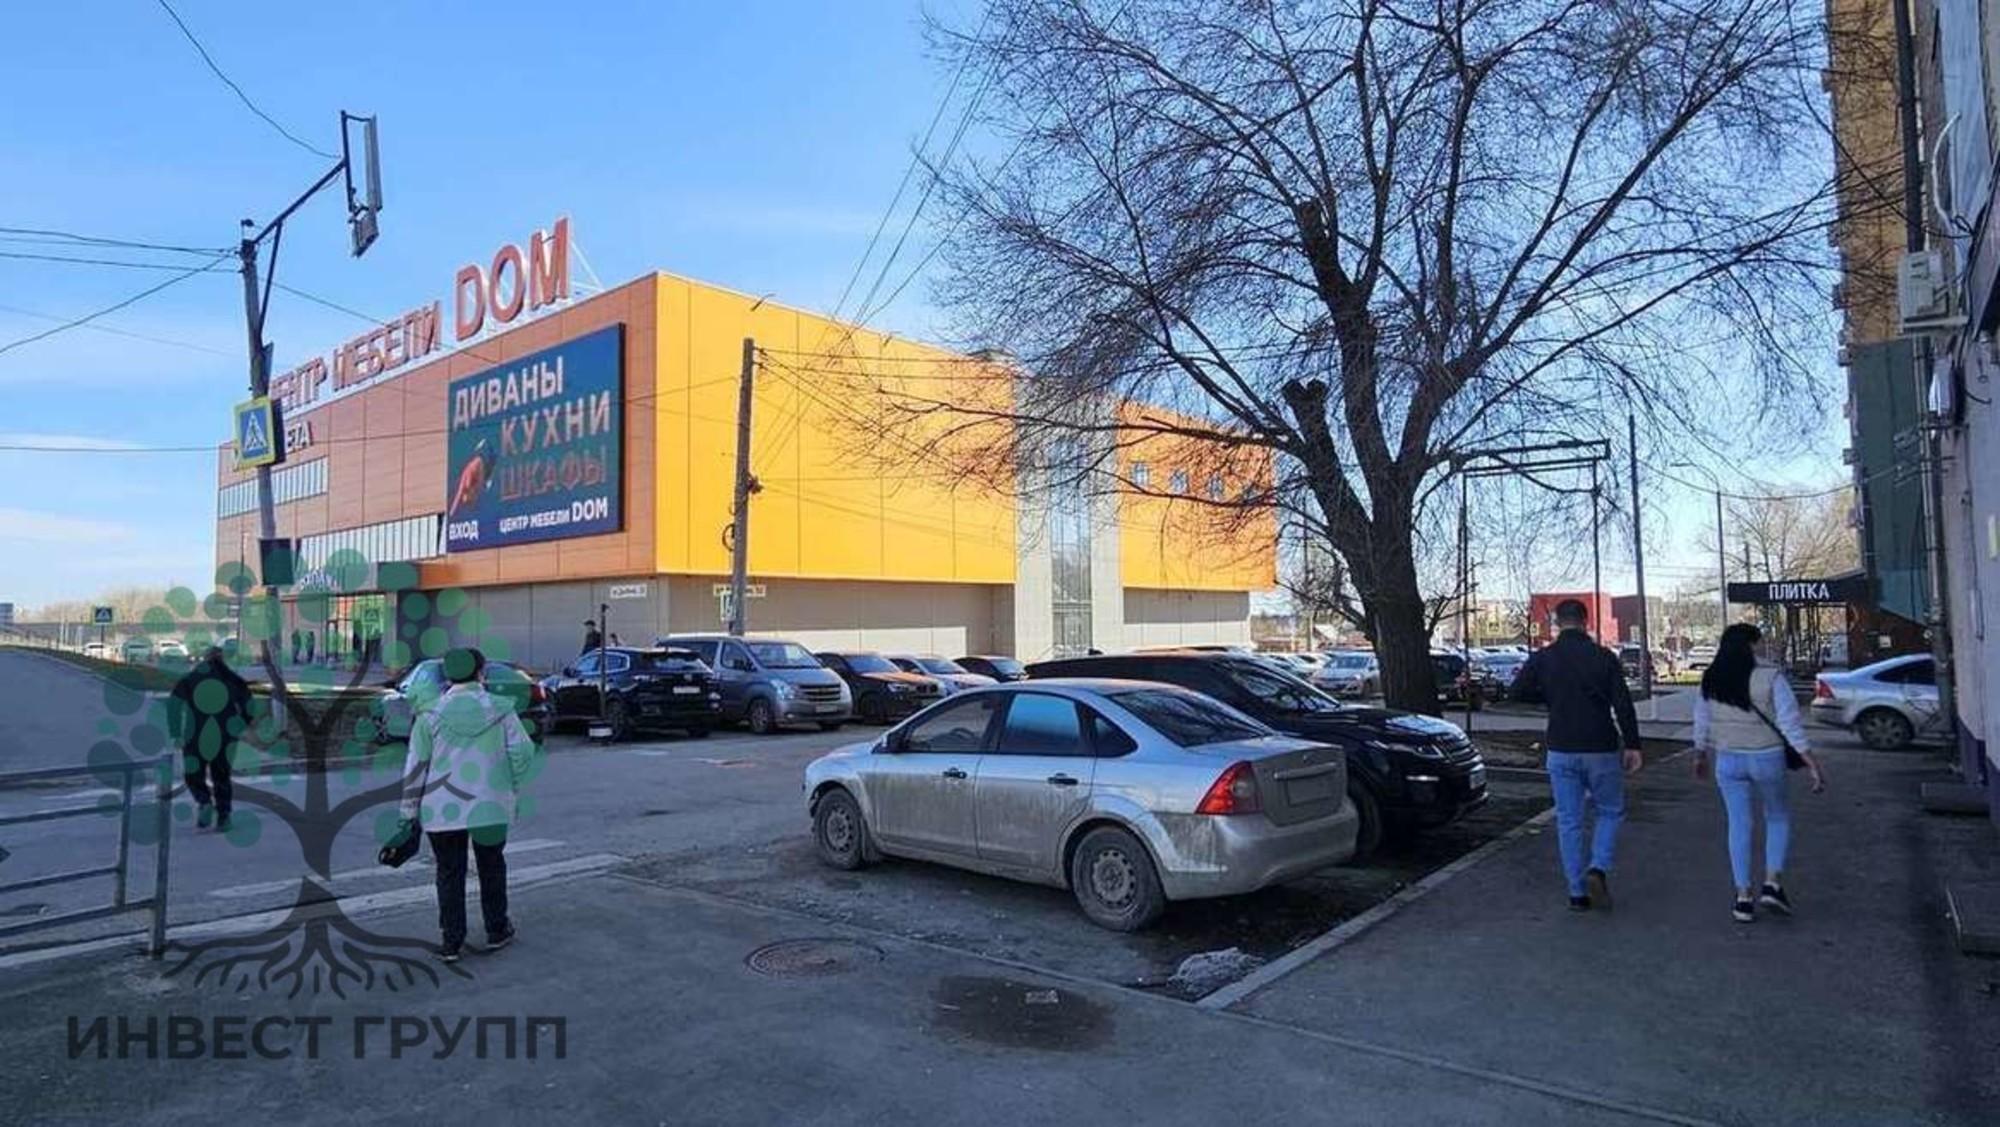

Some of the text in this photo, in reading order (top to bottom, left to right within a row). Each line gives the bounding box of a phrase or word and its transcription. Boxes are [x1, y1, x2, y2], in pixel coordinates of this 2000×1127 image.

[270, 217, 569, 413] ЕНТР МЕБЕЛИ DOM
[453, 355, 564, 432] ДИВАНЫ
[284, 421, 313, 454] ЕТА
[501, 390, 611, 457] КУХНИ
[501, 446, 608, 500] ШКАФЫ
[449, 519, 480, 540] ВХОД
[499, 496, 608, 534] ЦЕНТР МЕБЕЛИ DOM
[1768, 582, 1830, 600] ПЛИТКА
